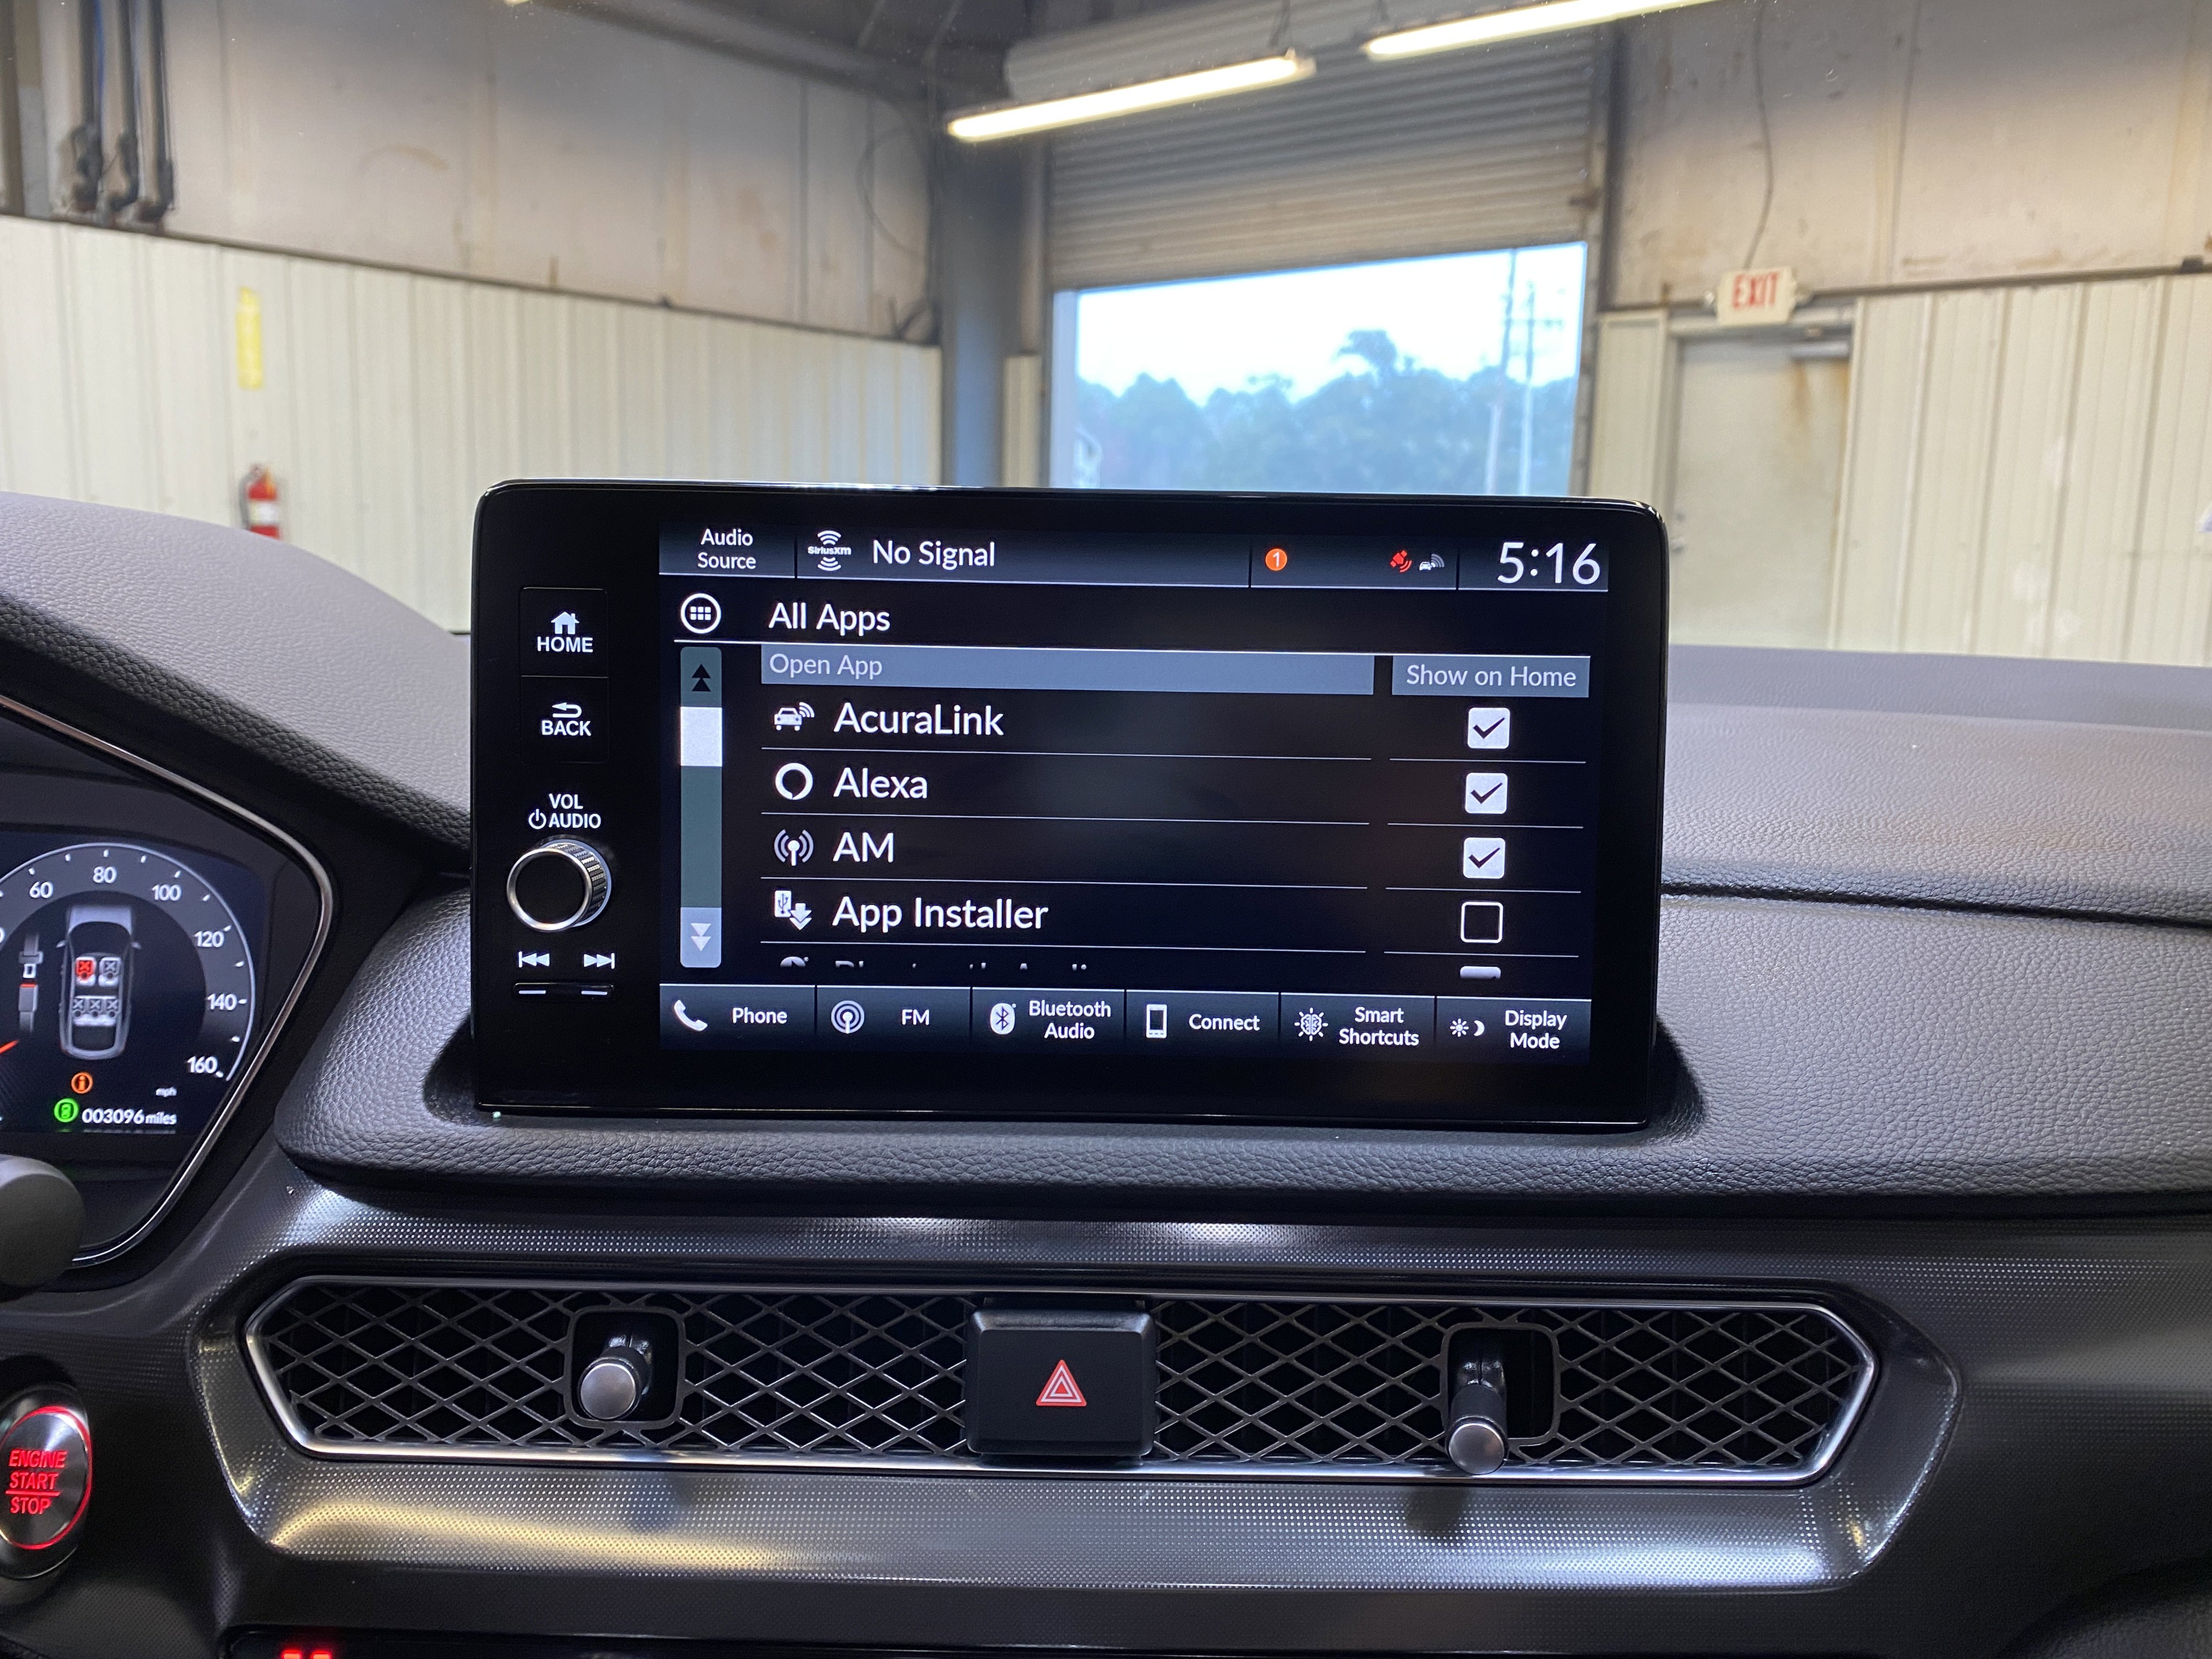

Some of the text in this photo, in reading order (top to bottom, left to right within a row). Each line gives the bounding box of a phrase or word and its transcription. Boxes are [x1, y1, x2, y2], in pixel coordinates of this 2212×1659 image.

[1731, 270, 1780, 311] EXIT
[700, 528, 754, 547] Audio
[697, 552, 757, 570] Source
[873, 539, 996, 571] No Signal
[1497, 541, 1601, 585] 5:16
[768, 602, 891, 636] All Apps
[537, 637, 594, 653] HOME
[770, 653, 883, 680] Open App
[1406, 664, 1577, 687] Show on Home
[541, 720, 592, 737] BACK
[833, 702, 1005, 736] AcuraLink
[833, 767, 928, 799] Alexa
[549, 793, 584, 810] VOL
[549, 812, 602, 830] AUDIO
[833, 832, 894, 863] AM
[93, 866, 117, 884] 80
[29, 881, 53, 899] 60
[152, 884, 182, 902] 100
[832, 896, 1049, 933] App Installer
[194, 930, 224, 949] 120
[207, 992, 238, 1012] 140
[1029, 999, 1112, 1018] Bluetooth
[732, 1006, 788, 1025] Phone
[902, 1009, 930, 1026] FM
[1188, 1013, 1261, 1031] Connect
[1355, 1006, 1404, 1024] Smart
[1505, 1009, 1568, 1030] Display
[1044, 1022, 1096, 1040] Audio
[1339, 1028, 1420, 1047] Shortcuts
[1510, 1033, 1561, 1050] Mode
[187, 1056, 218, 1074] 160
[82, 1108, 177, 1125] 003096 miles
[8, 1449, 68, 1469] ENGINE
[9, 1471, 59, 1491] START
[9, 1496, 52, 1515] STOP
